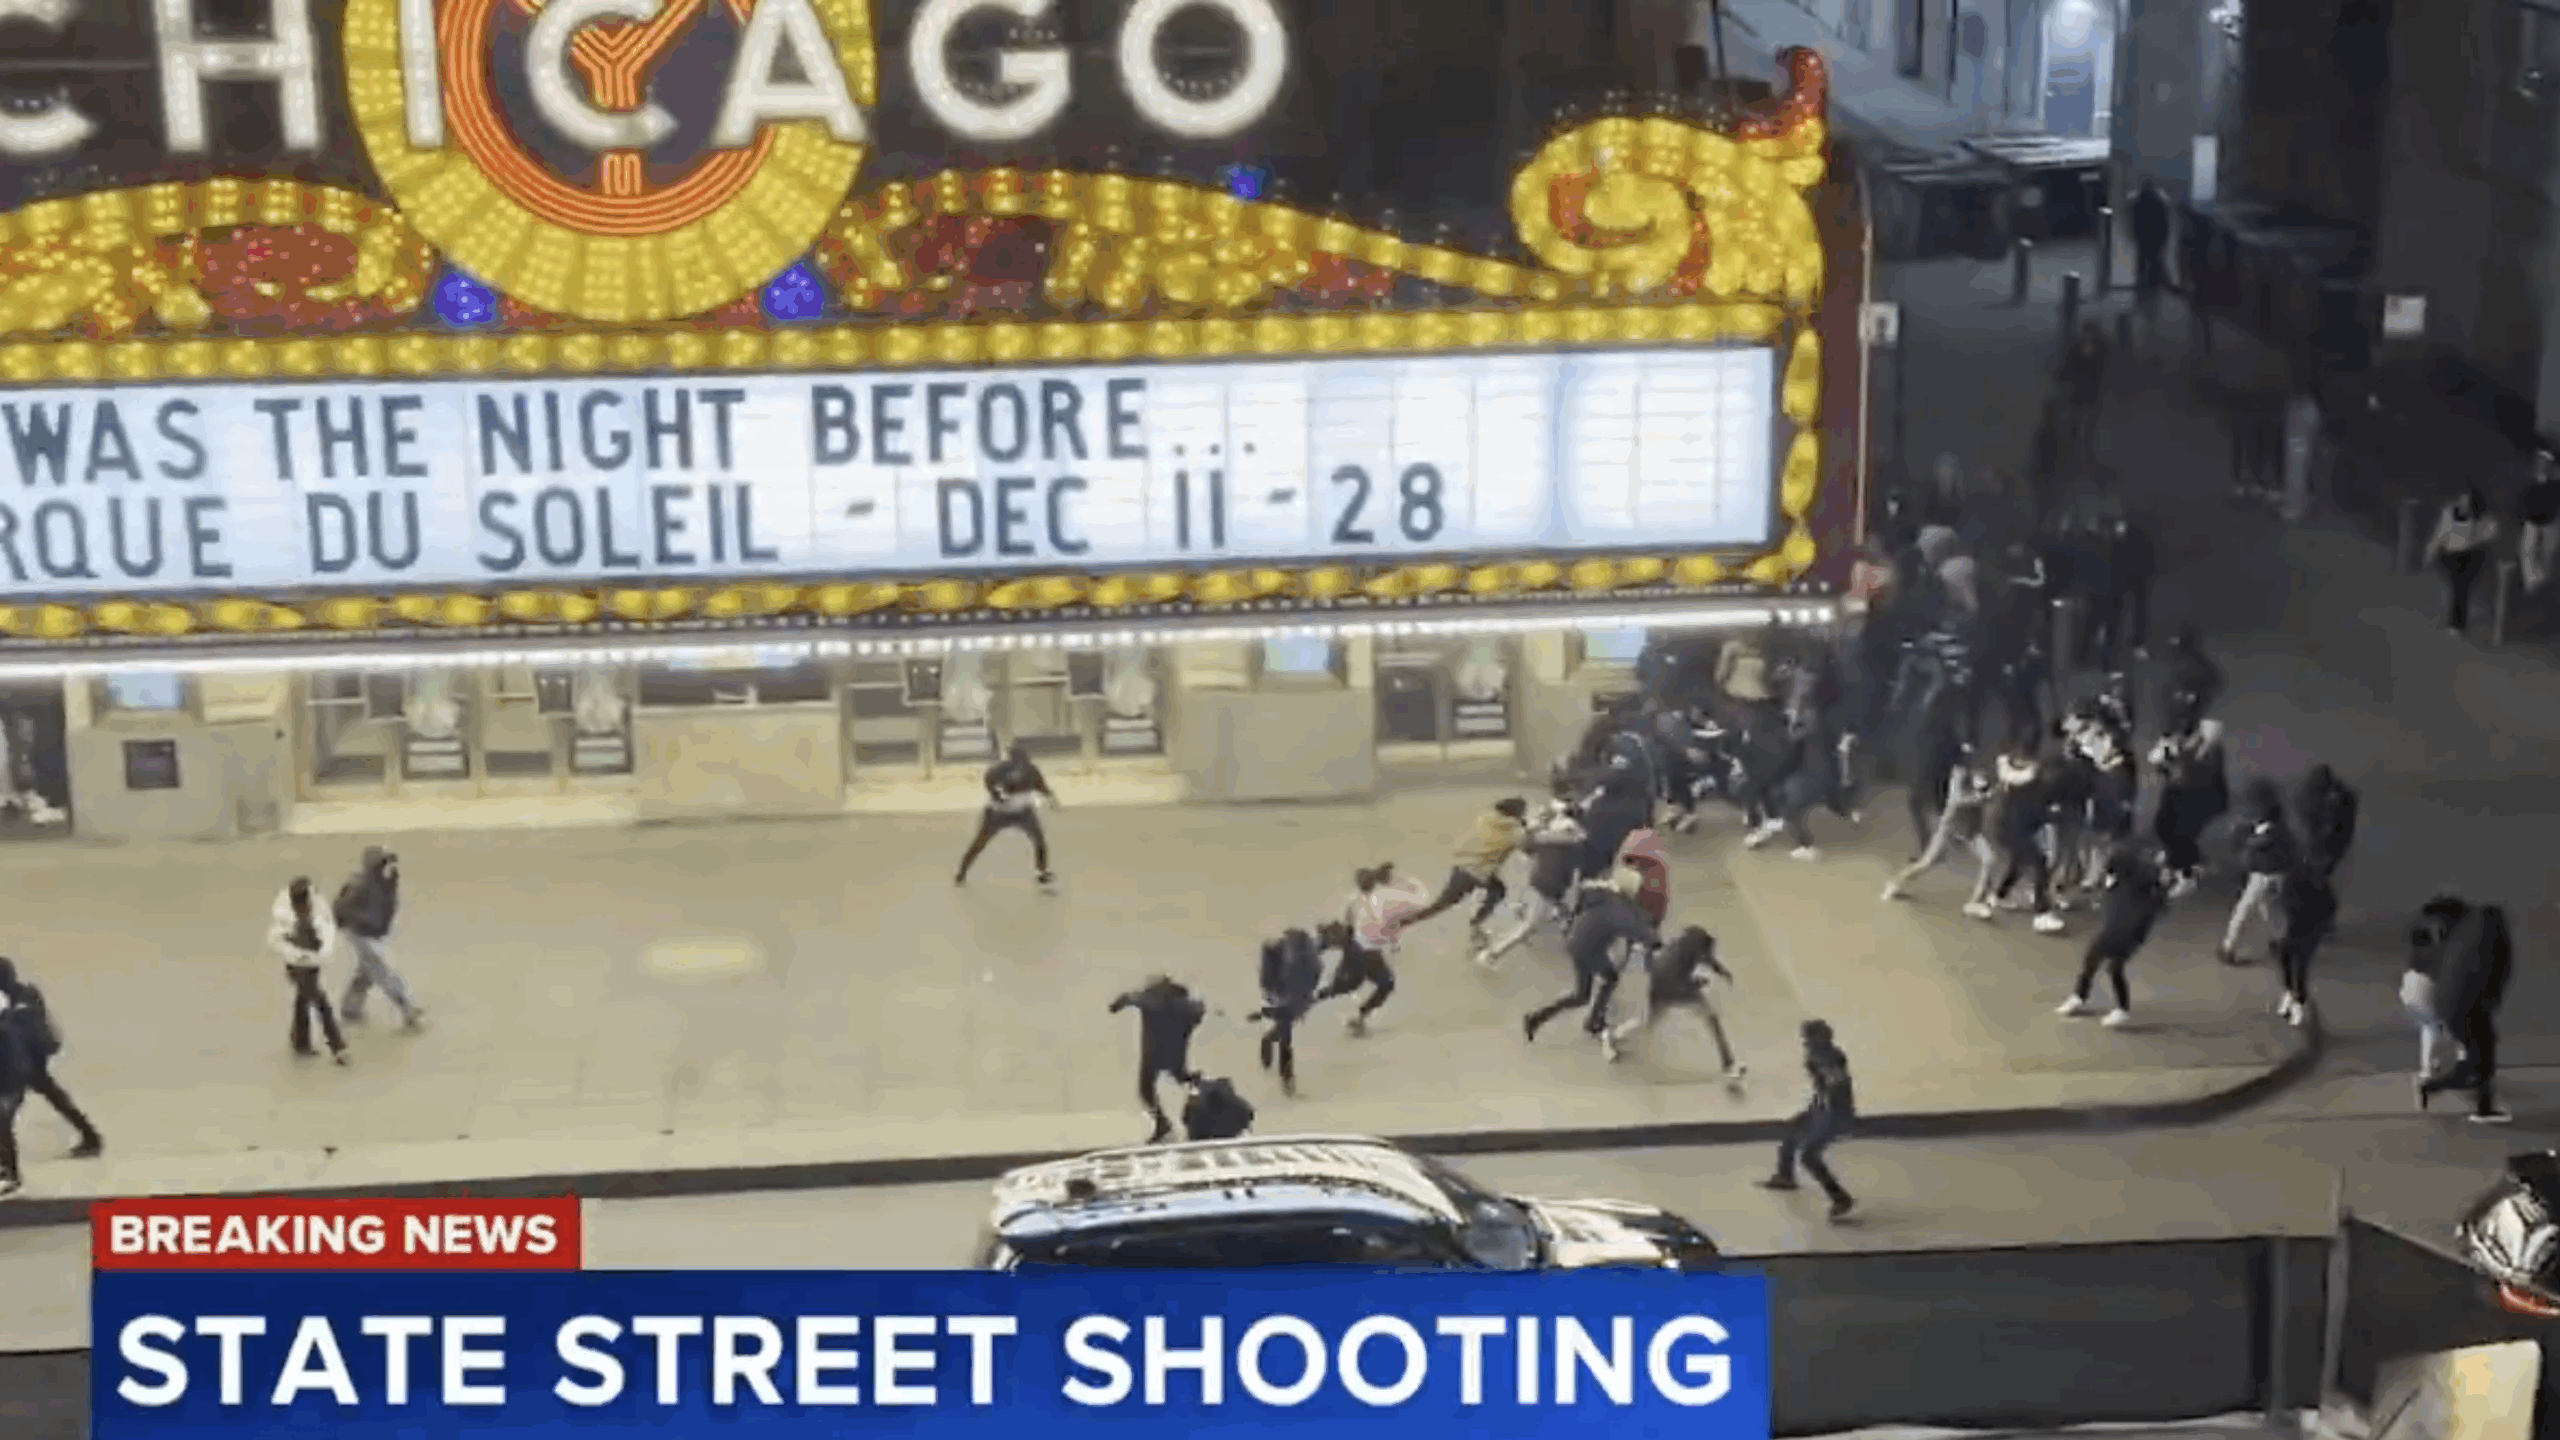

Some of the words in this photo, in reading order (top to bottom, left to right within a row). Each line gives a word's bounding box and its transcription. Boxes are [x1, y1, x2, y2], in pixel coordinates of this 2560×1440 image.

[0, 398, 208, 487] WAS
[253, 393, 428, 480] THE
[476, 387, 746, 476] NIGHT
[306, 490, 422, 574] DU
[477, 484, 780, 572] SOLEIL
[937, 476, 1091, 559] DEC
